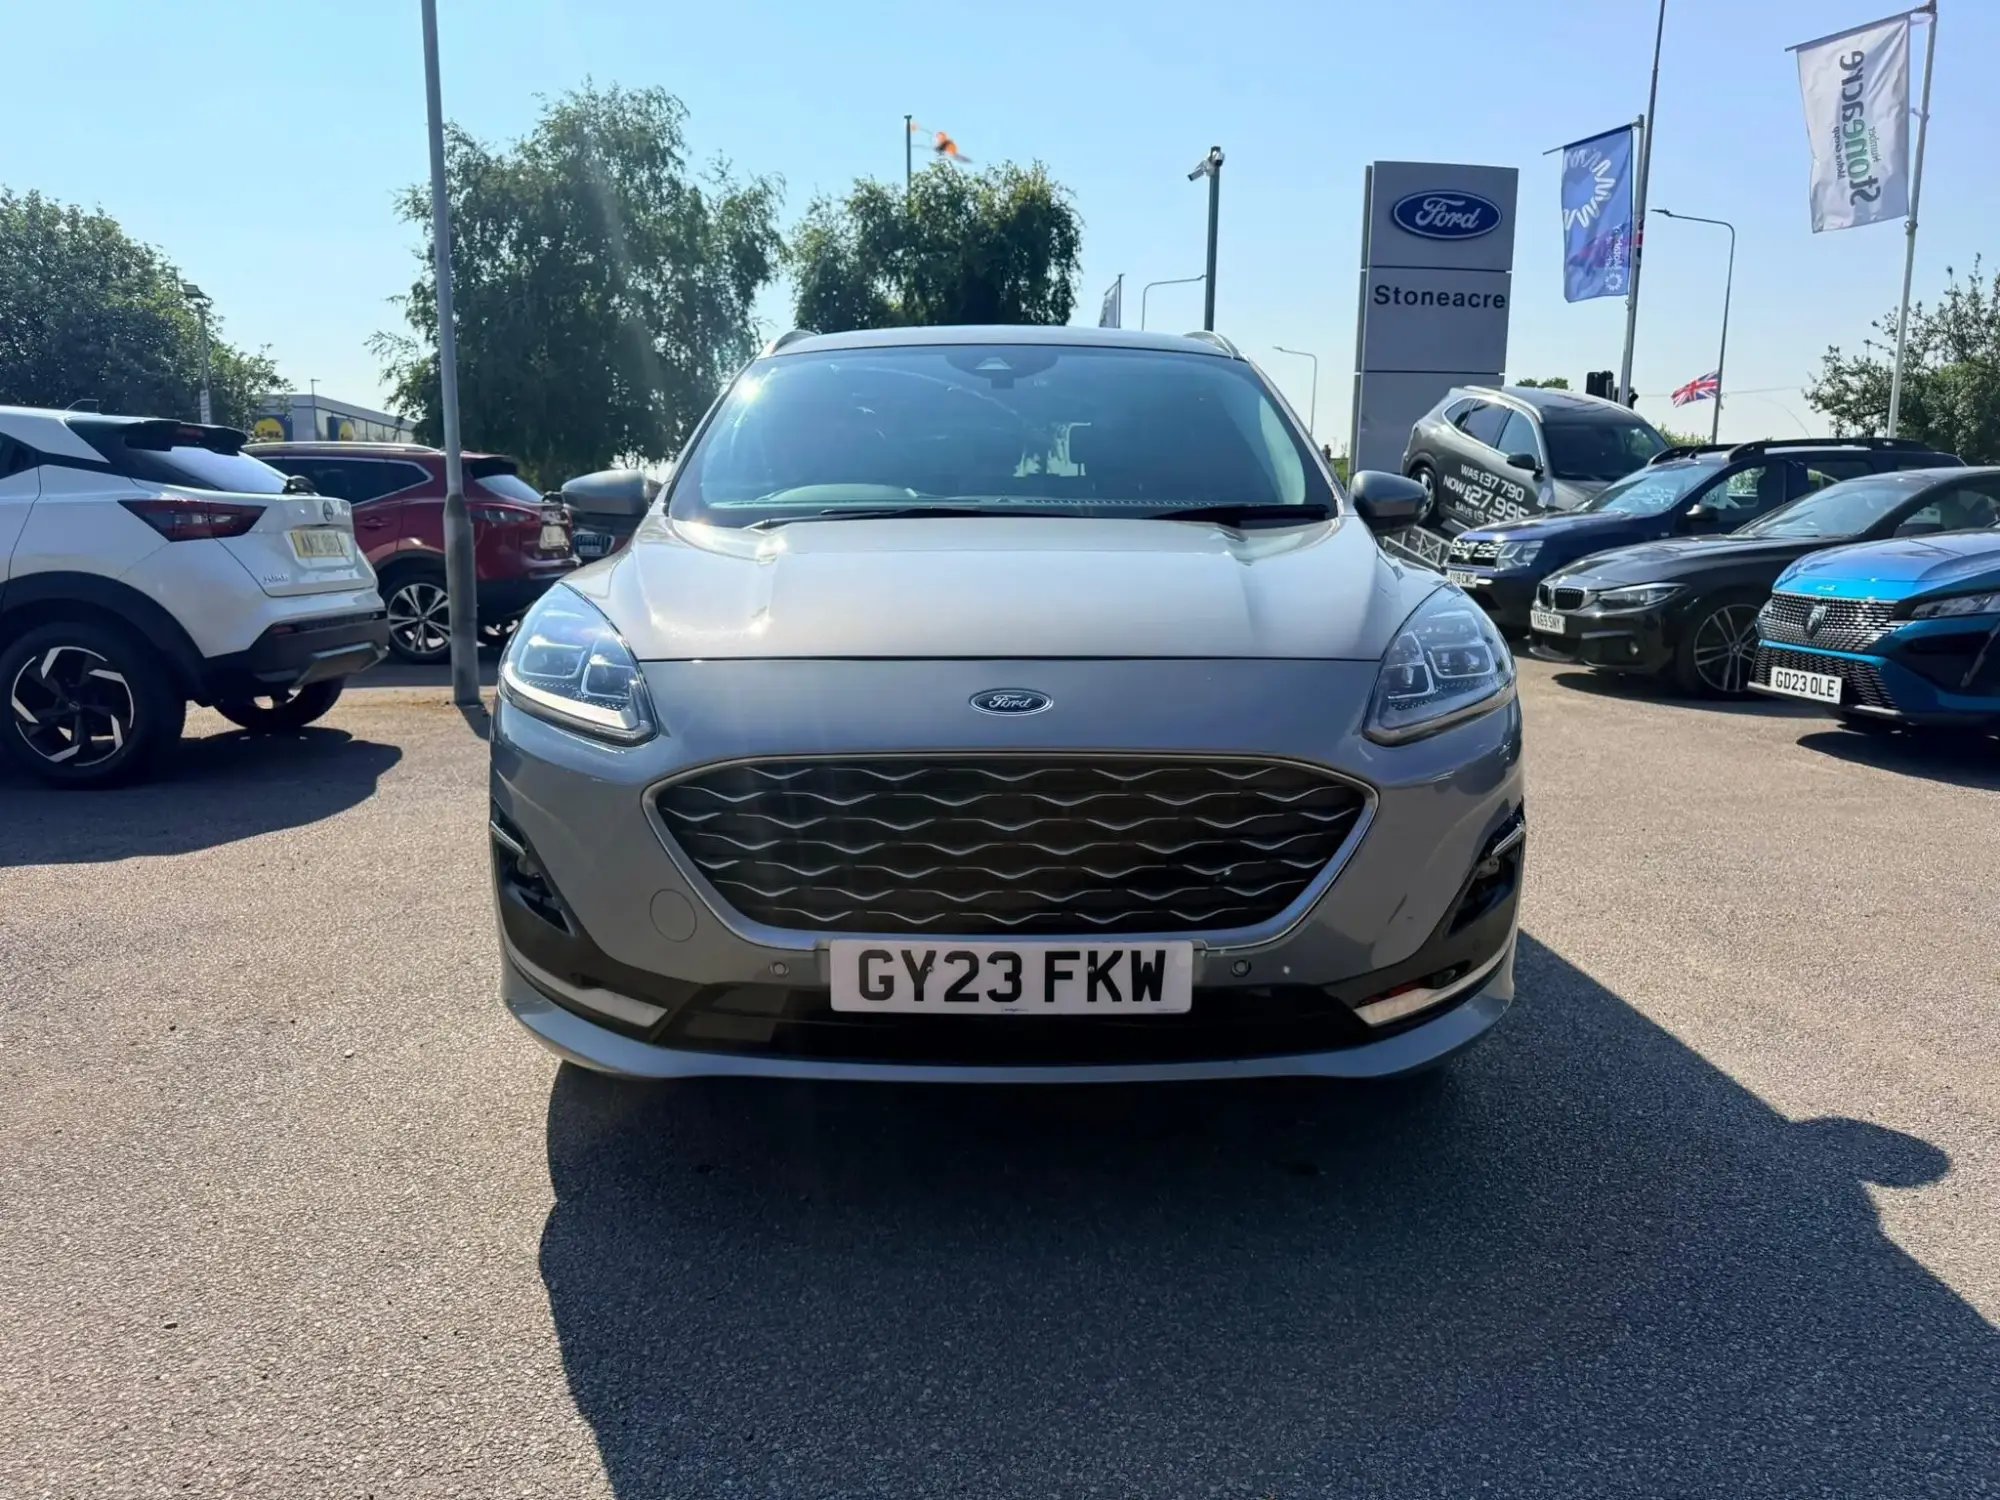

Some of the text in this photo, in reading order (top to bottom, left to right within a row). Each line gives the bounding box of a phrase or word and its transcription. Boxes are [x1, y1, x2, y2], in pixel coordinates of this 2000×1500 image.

[1415, 197, 1481, 229] Ford
[1373, 284, 1506, 309] Stoneacre
[1443, 475, 1466, 494] NOW
[1461, 464, 1479, 481] WAS
[1775, 671, 1836, 698] GD23 OLE
[988, 694, 1033, 708] Ford
[858, 949, 1167, 1003] GY23 FKW
